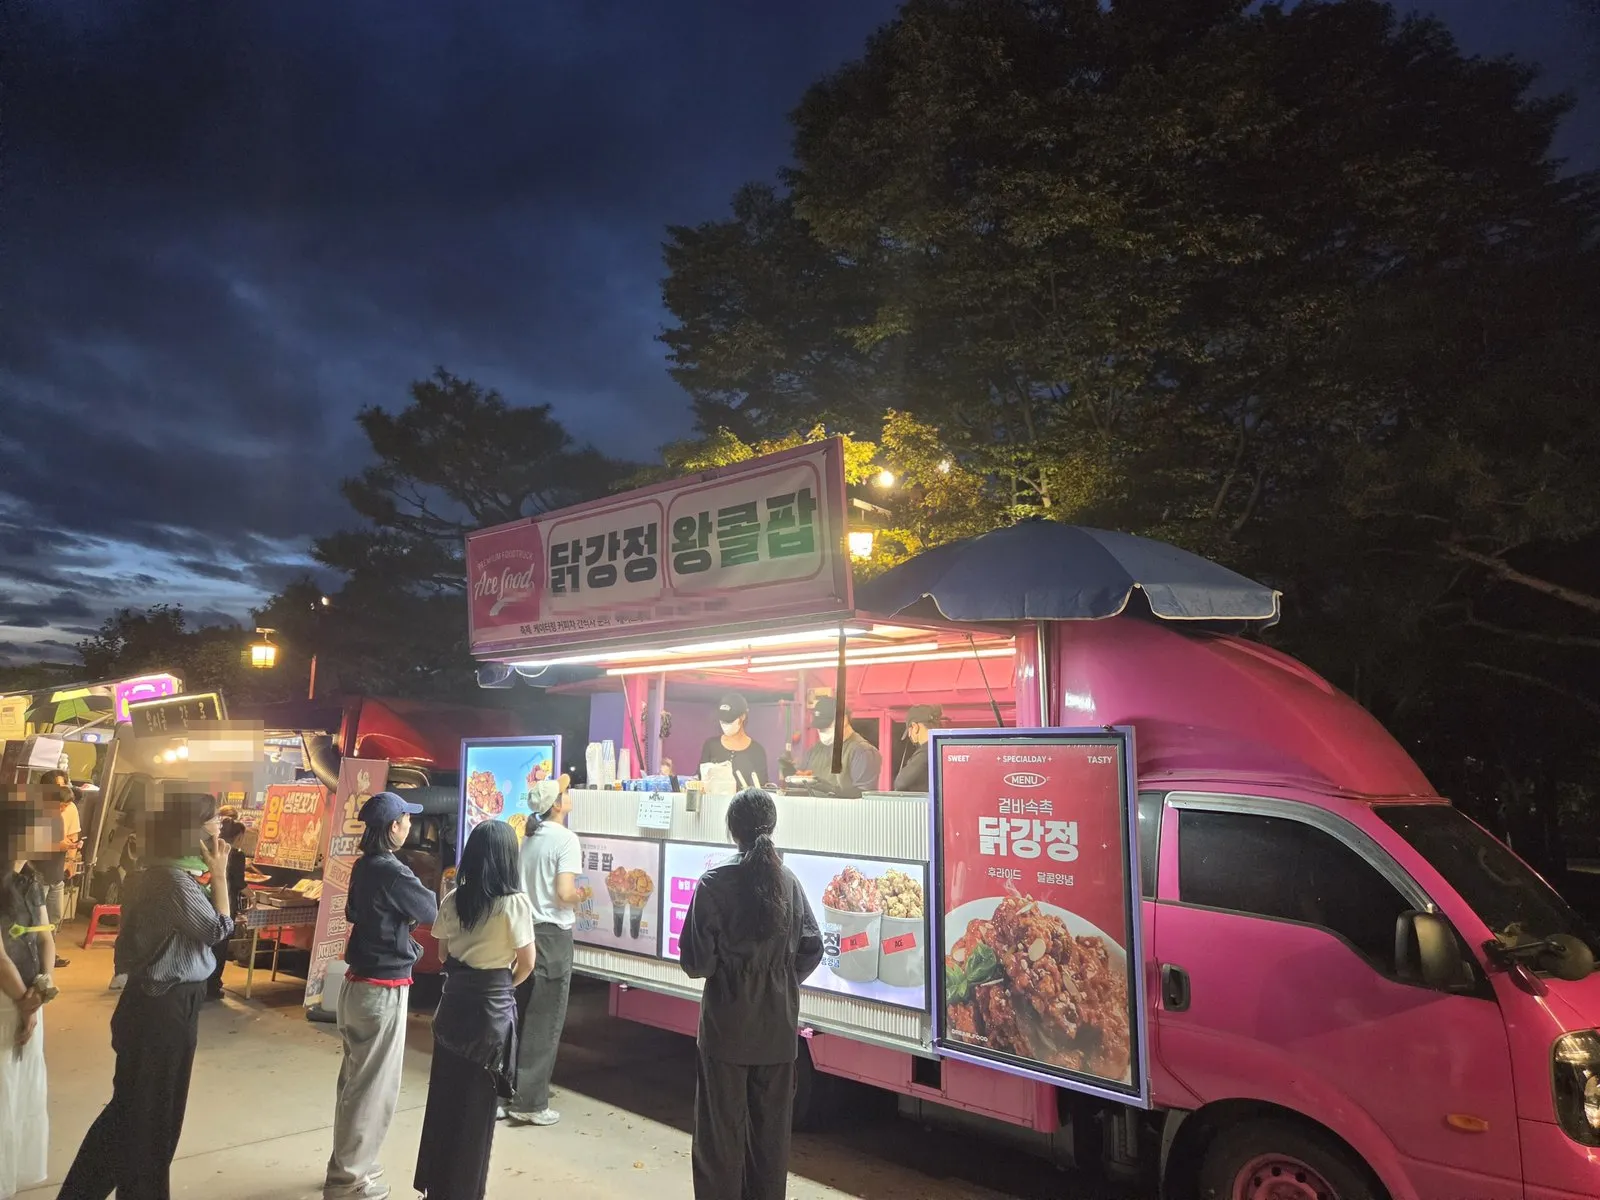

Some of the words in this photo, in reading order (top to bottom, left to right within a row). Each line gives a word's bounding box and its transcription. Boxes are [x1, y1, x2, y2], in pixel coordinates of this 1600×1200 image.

[550, 523, 657, 593] 닭강정
[671, 487, 817, 575] 왕콜팝
[474, 571, 499, 600] Ace
[1002, 755, 1047, 763] SPECIALDAY
[1087, 756, 1113, 764] TASTY
[1011, 775, 1038, 785] MENU
[264, 795, 285, 840] 왕
[998, 797, 1053, 816] 겉바속촉
[978, 816, 1079, 862] 닭강정
[988, 867, 1021, 880] 후라이드
[1037, 871, 1074, 886] 달콤양념
